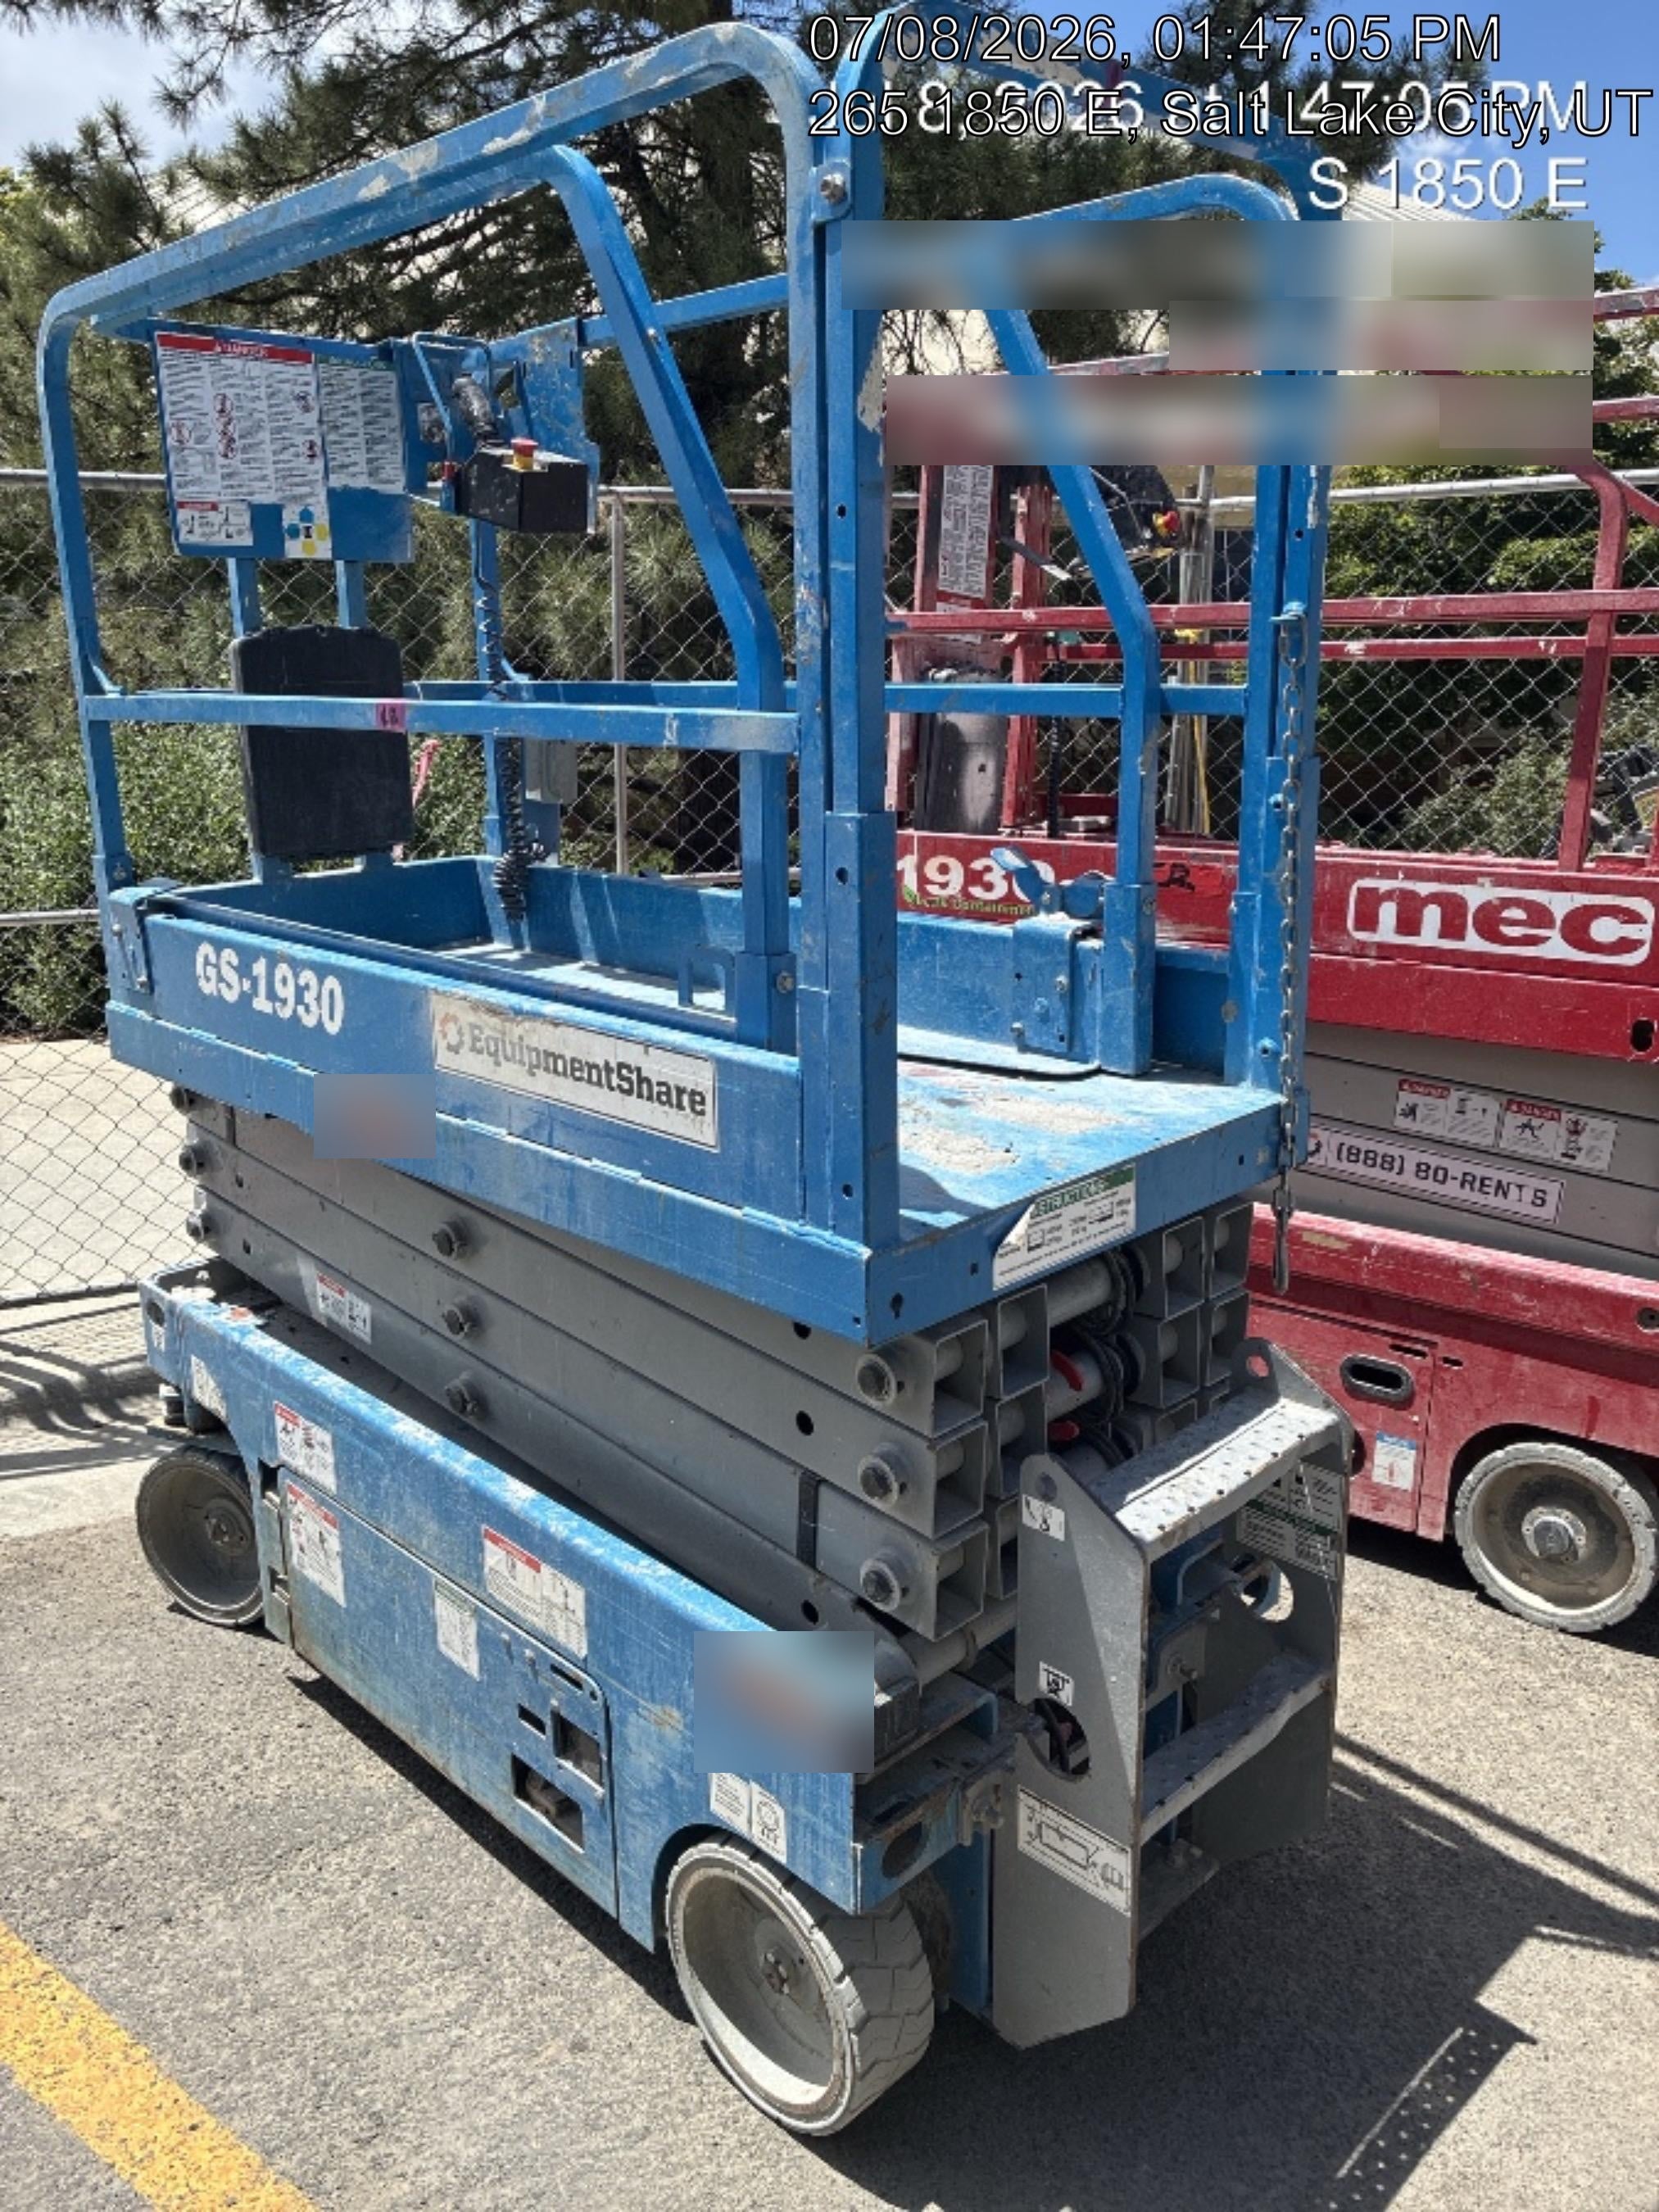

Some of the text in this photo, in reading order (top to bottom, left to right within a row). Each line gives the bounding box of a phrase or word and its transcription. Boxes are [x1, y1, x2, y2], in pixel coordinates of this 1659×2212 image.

[1353, 886, 1648, 956] mec
[196, 941, 345, 1036] GS-1930
[468, 1022, 707, 1117] EquipmentShare
[1335, 1141, 1548, 1208] (888) 80-RENTS
